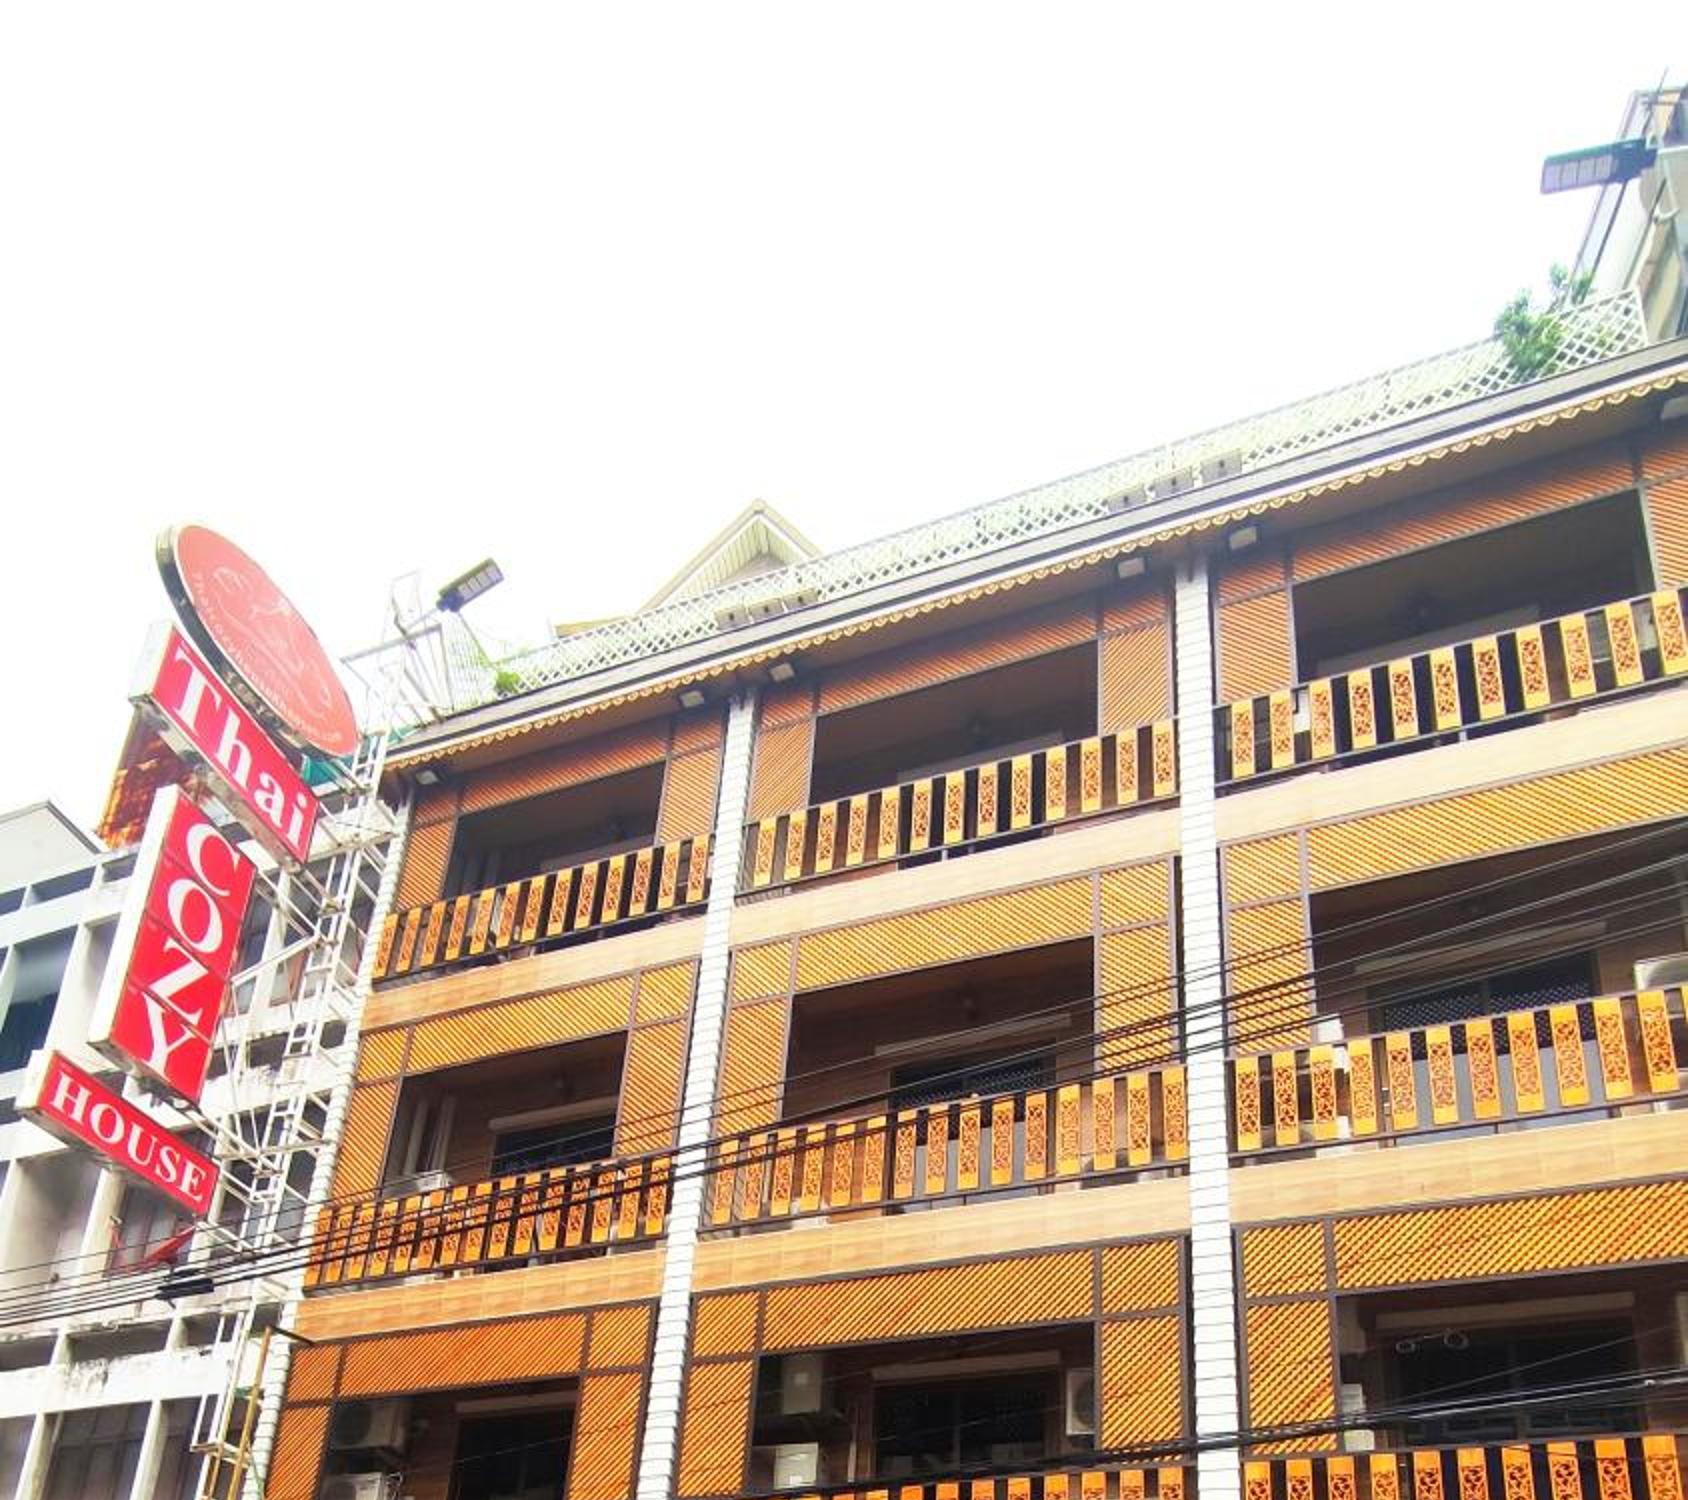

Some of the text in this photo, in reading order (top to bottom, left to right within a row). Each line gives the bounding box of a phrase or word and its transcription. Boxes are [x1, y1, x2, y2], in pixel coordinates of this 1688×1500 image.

[174, 646, 308, 852] Thai
[143, 822, 240, 1080] COZY
[50, 1070, 207, 1202] HOUSE
